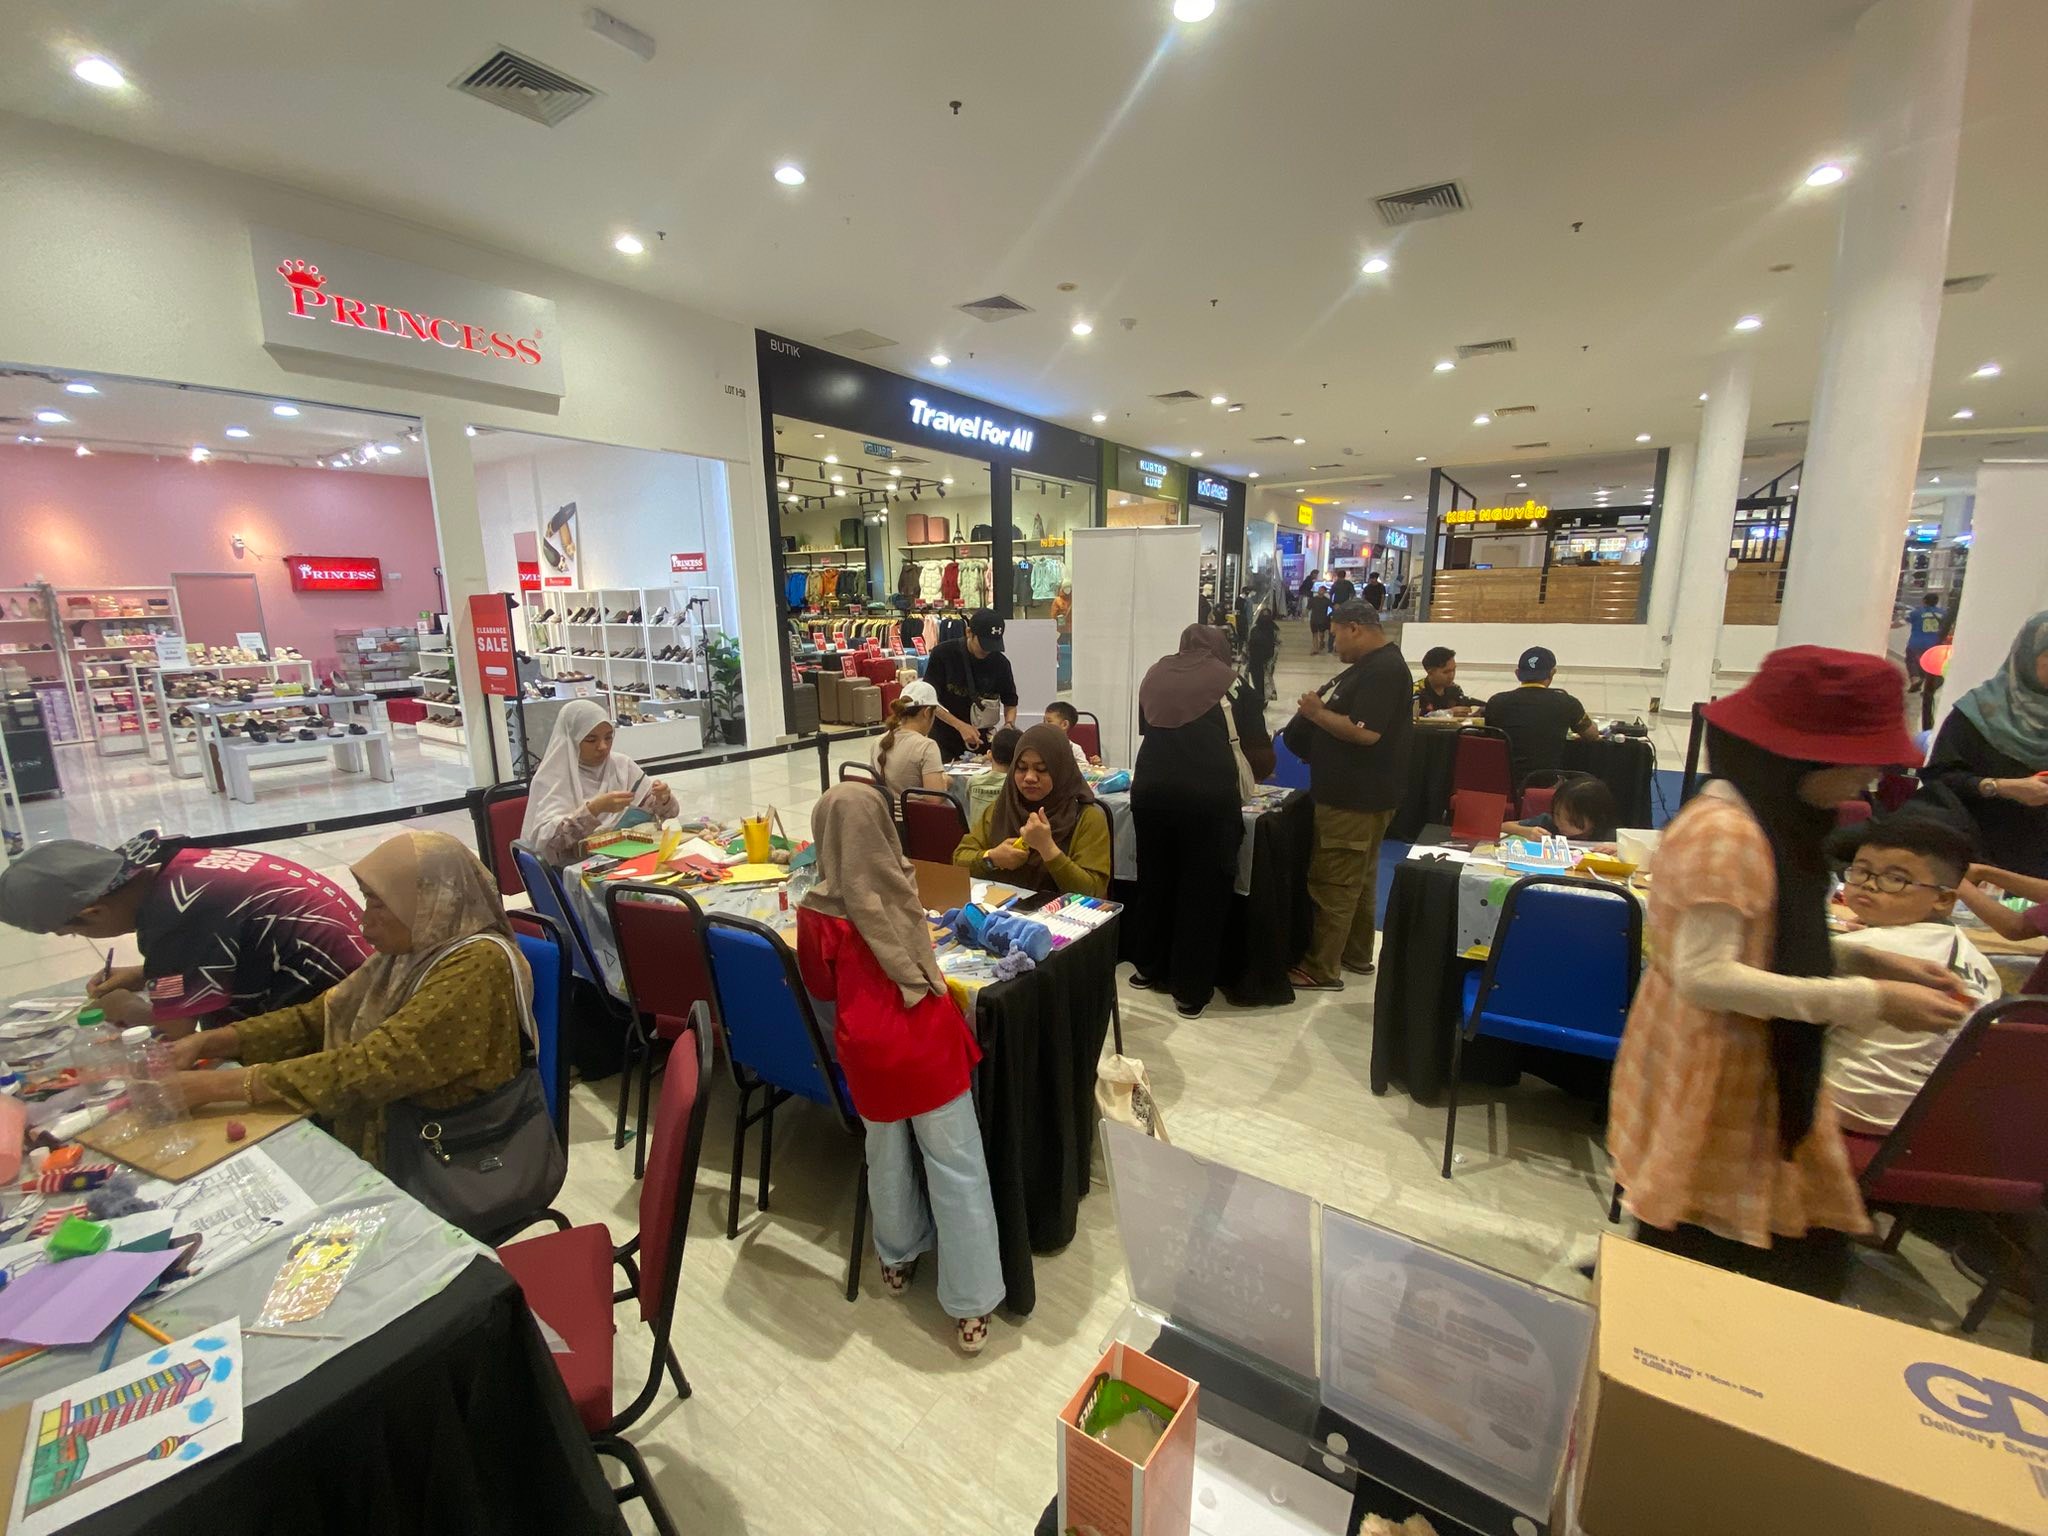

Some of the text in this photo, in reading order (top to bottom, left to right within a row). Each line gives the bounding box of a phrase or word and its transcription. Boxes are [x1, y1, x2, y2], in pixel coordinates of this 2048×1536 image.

[284, 284, 542, 367] PRINCESS
[770, 338, 800, 358] BUTIK
[910, 398, 1034, 452] Travel For All
[1145, 476, 1162, 489] LUXE
[1446, 510, 1476, 523] KEE
[302, 570, 376, 580] PRINCESS
[476, 626, 507, 634] CLEARANCE
[477, 636, 509, 652] SALE
[1919, 1413, 1996, 1450] Delivery
